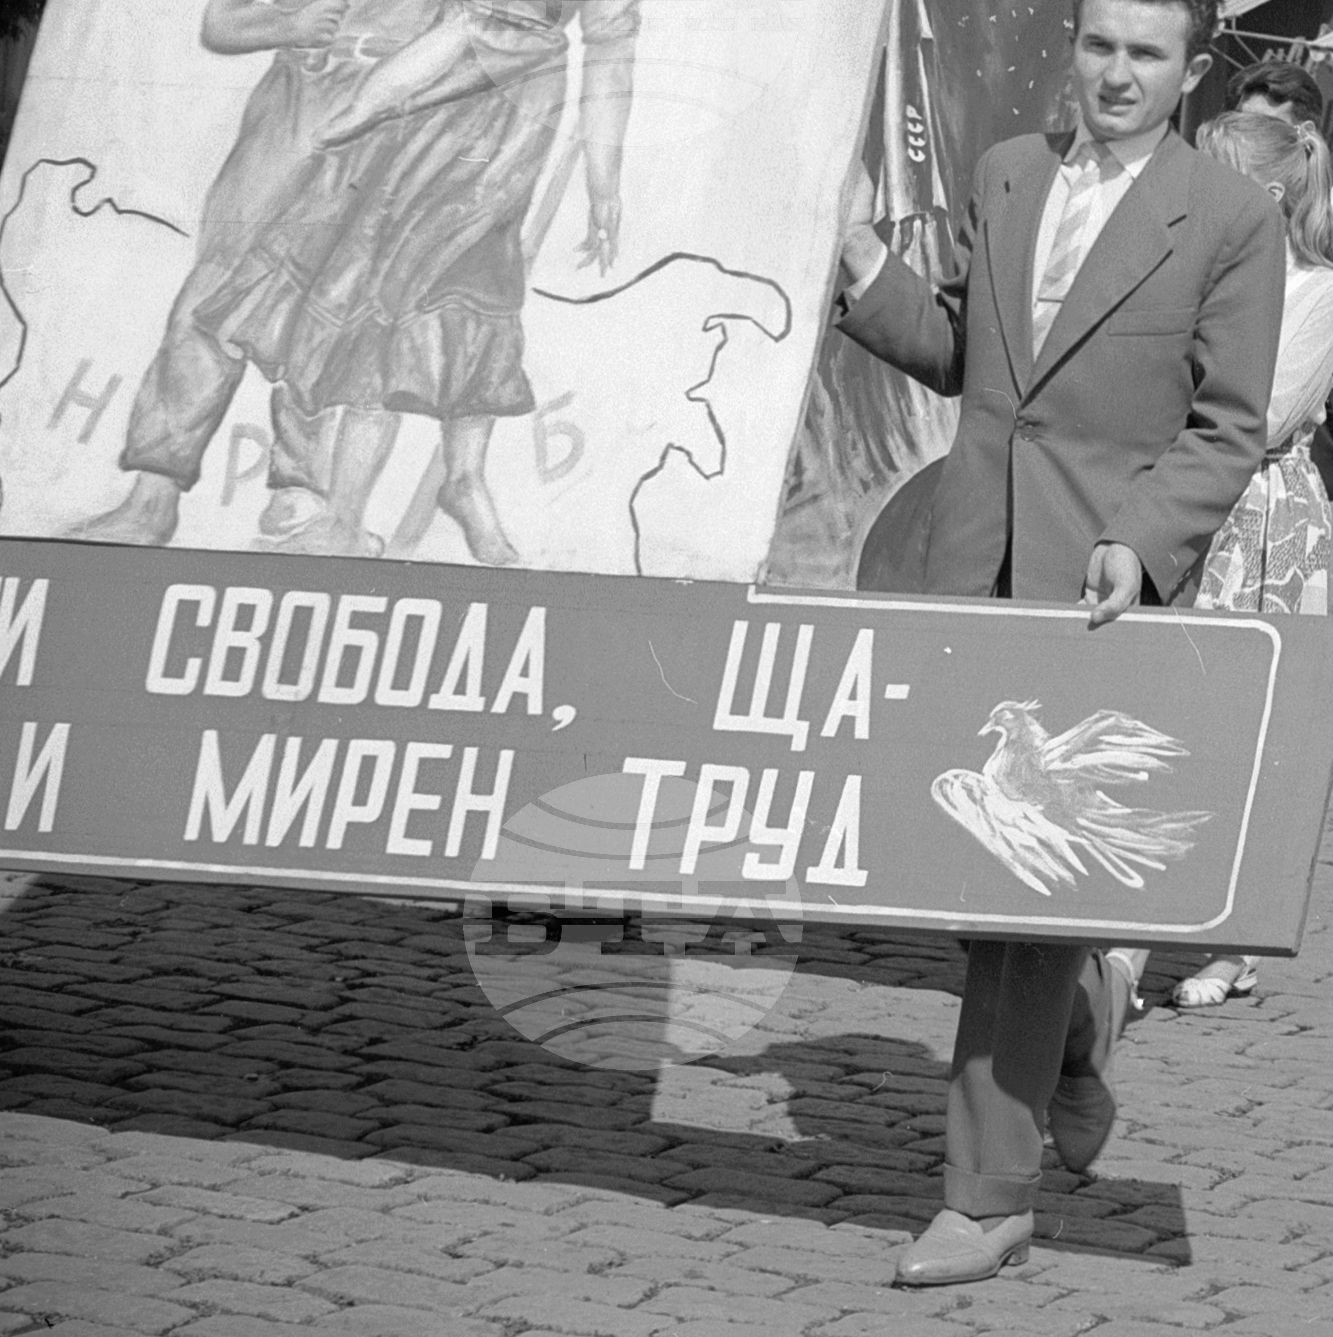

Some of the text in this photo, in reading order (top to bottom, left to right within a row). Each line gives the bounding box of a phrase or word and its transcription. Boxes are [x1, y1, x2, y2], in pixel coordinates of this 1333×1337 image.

[145, 583, 577, 731] СВОБОДА,
[712, 620, 910, 751] ЩА-
[4, 721, 869, 887] И МИРЕН ТРУД
